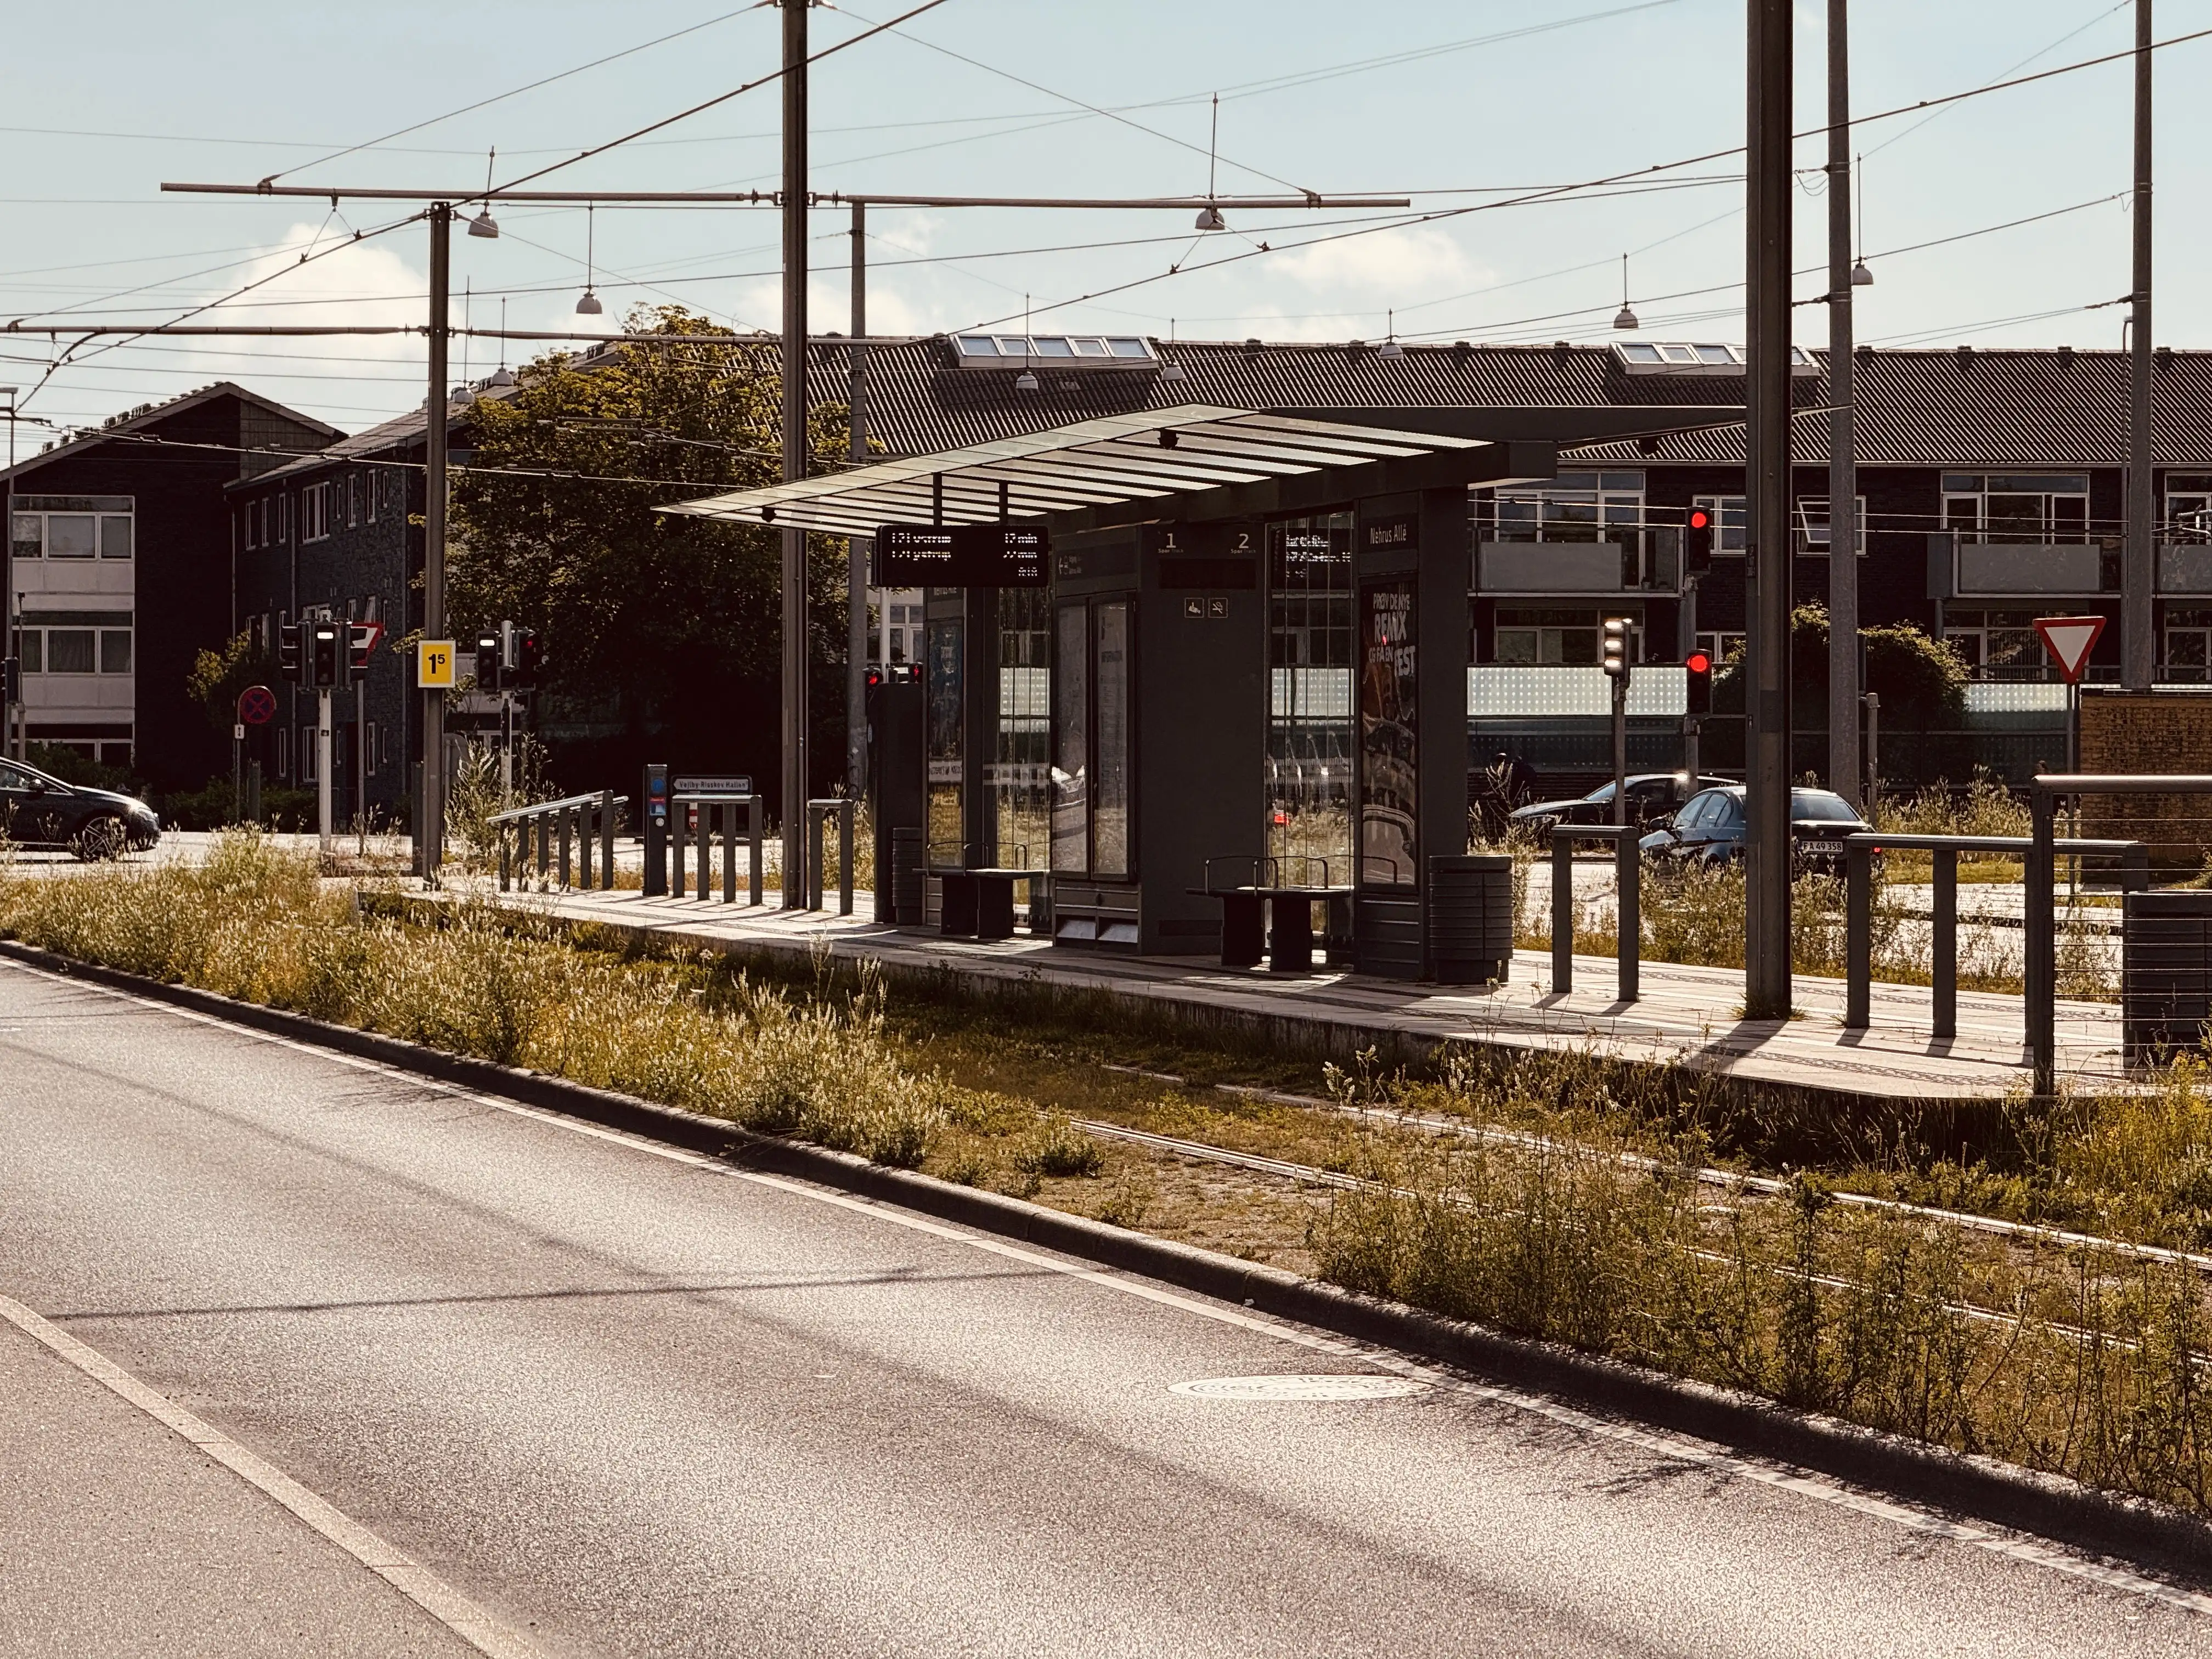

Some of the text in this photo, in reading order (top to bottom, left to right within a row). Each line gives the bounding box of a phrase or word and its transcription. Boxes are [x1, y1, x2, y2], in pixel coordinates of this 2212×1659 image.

[1166, 533, 1176, 548] 1
[1239, 533, 1249, 549] 2
[1370, 523, 1407, 544] Nehrus Allé
[1373, 593, 1389, 610] PRØV
[1374, 610, 1407, 644] REMIX
[1393, 645, 1415, 679] FEST
